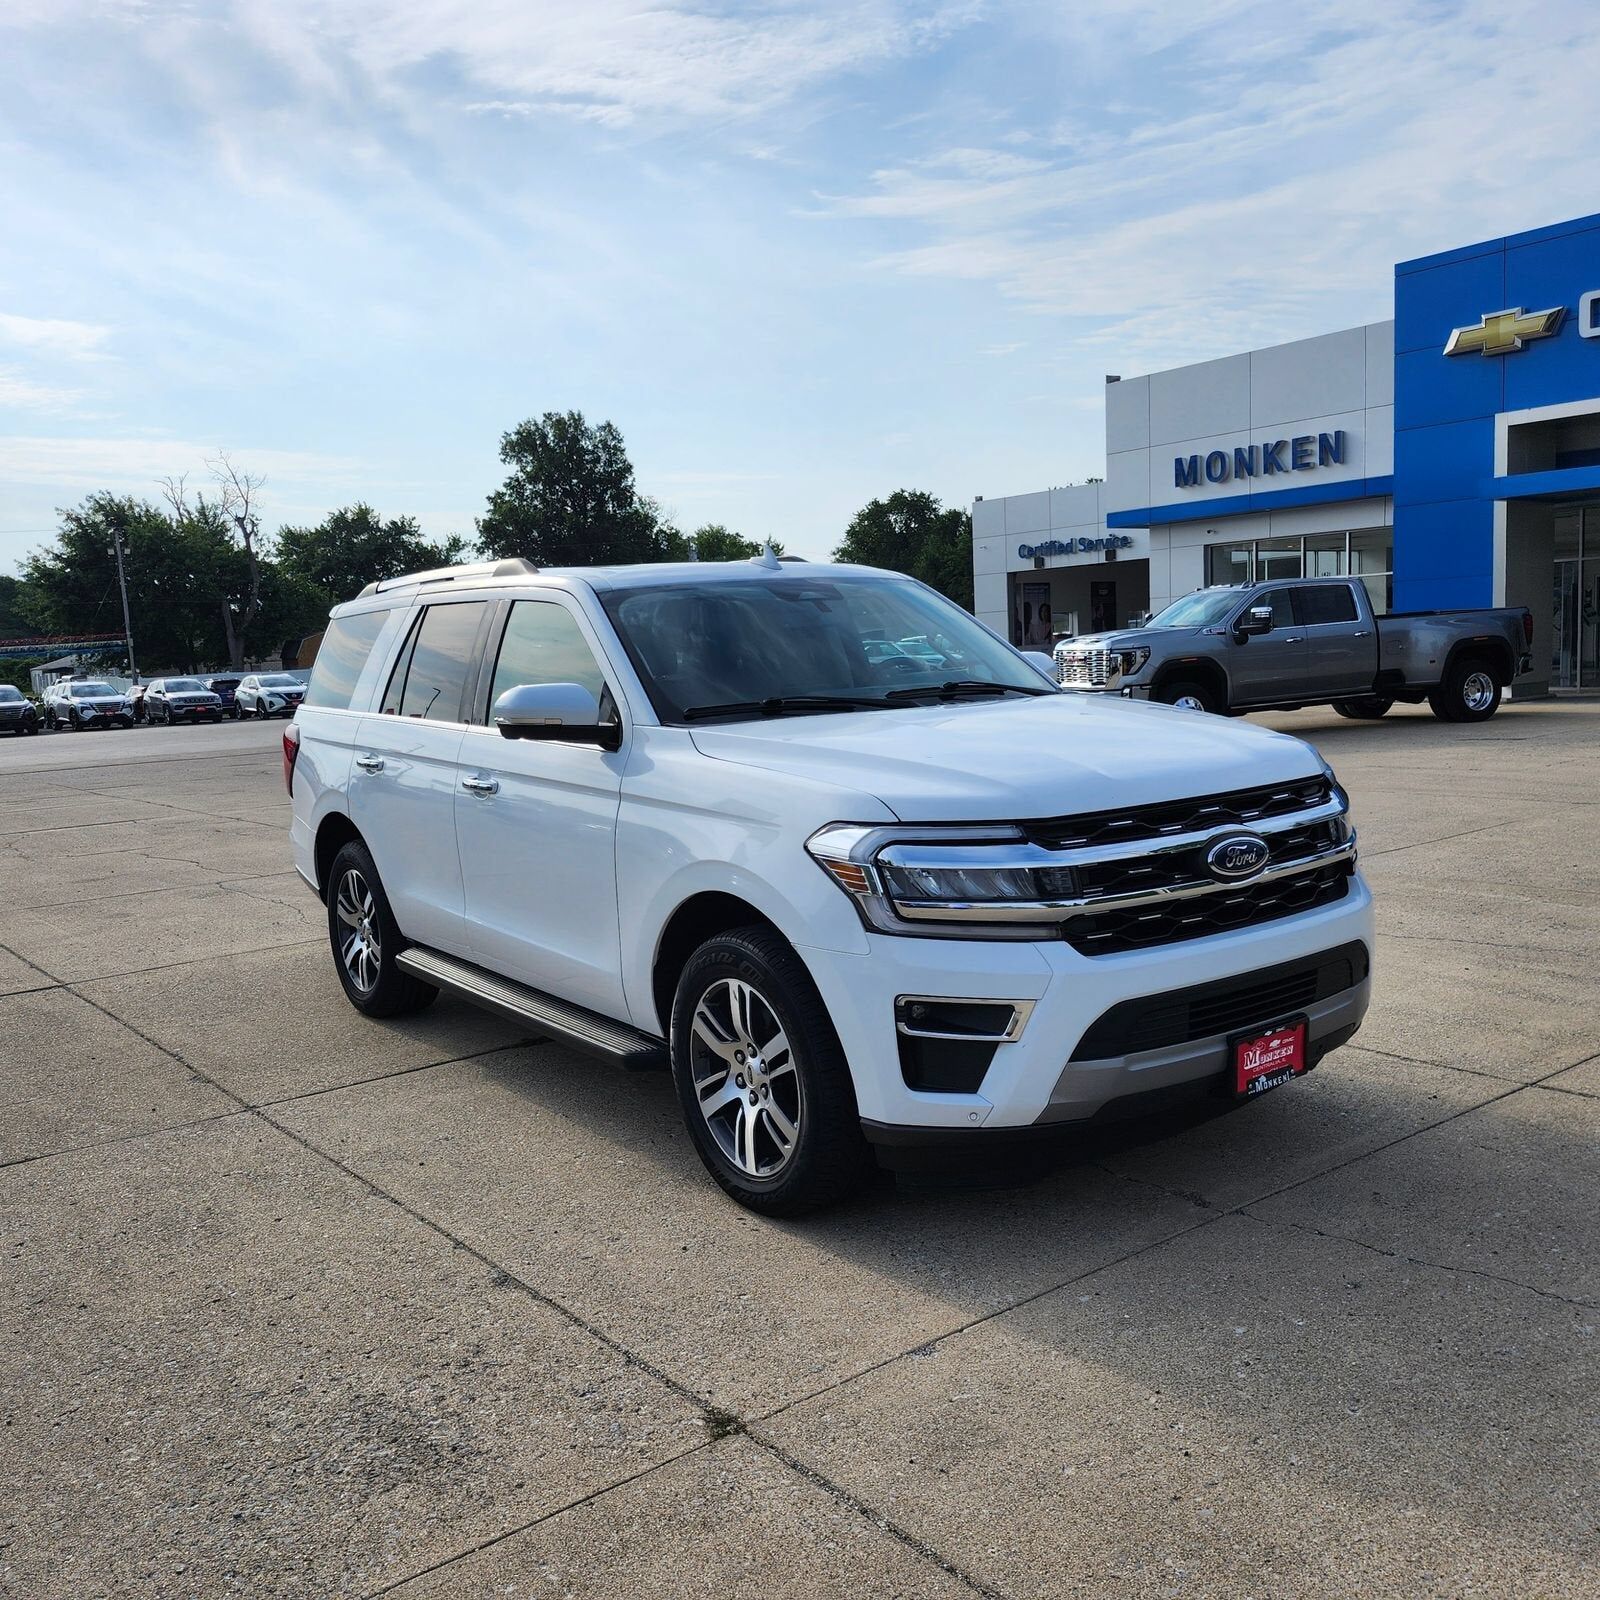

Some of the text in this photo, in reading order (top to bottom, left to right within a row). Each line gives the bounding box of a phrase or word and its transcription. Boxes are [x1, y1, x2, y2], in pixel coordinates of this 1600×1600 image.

[1174, 430, 1346, 488] MONKEN
[1018, 533, 1134, 559] Certified Service
[1225, 844, 1258, 868] Ford
